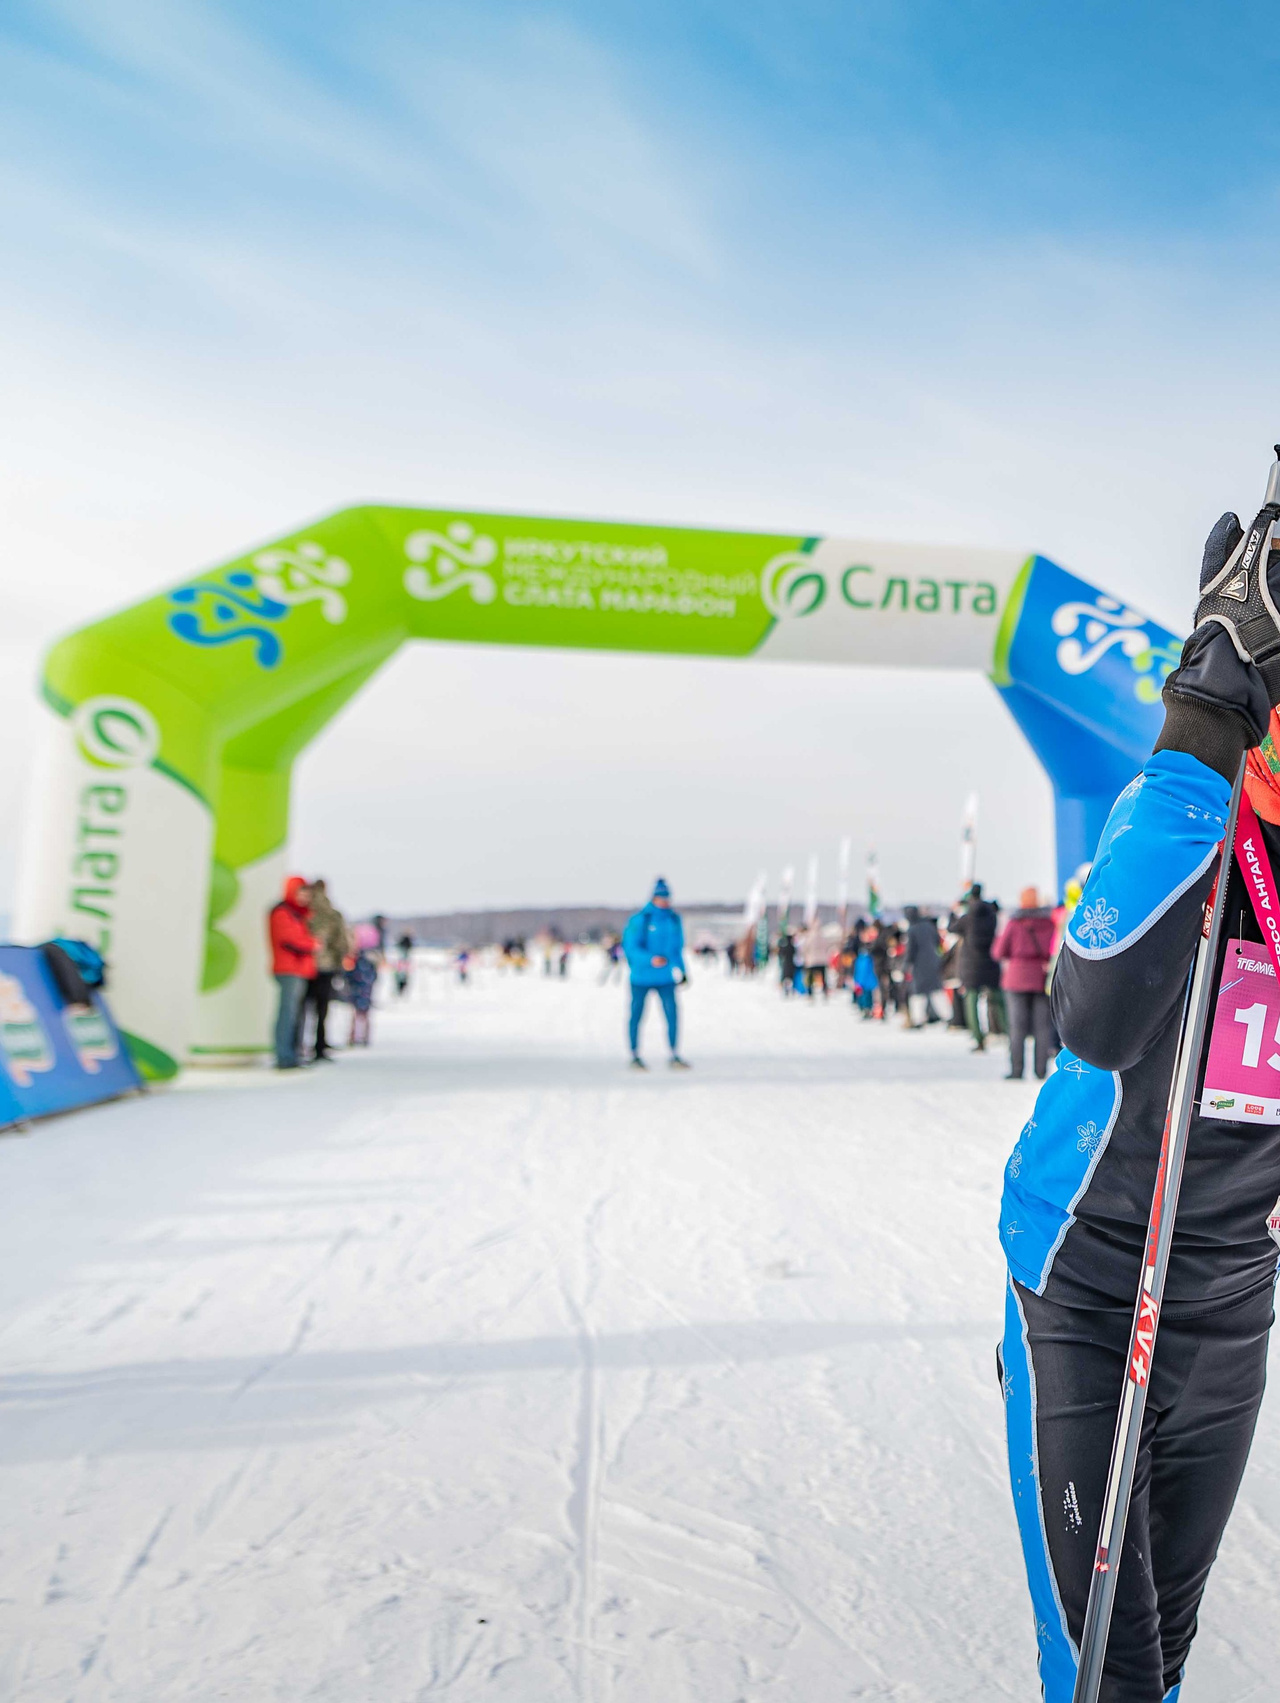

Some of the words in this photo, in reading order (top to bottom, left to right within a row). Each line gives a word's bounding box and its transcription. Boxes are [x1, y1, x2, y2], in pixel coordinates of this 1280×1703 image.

[841, 564, 997, 615] Слата
[72, 784, 127, 952] лата
[1242, 837, 1272, 910] АНГАРА
[1132, 1294, 1158, 1387] KV+
